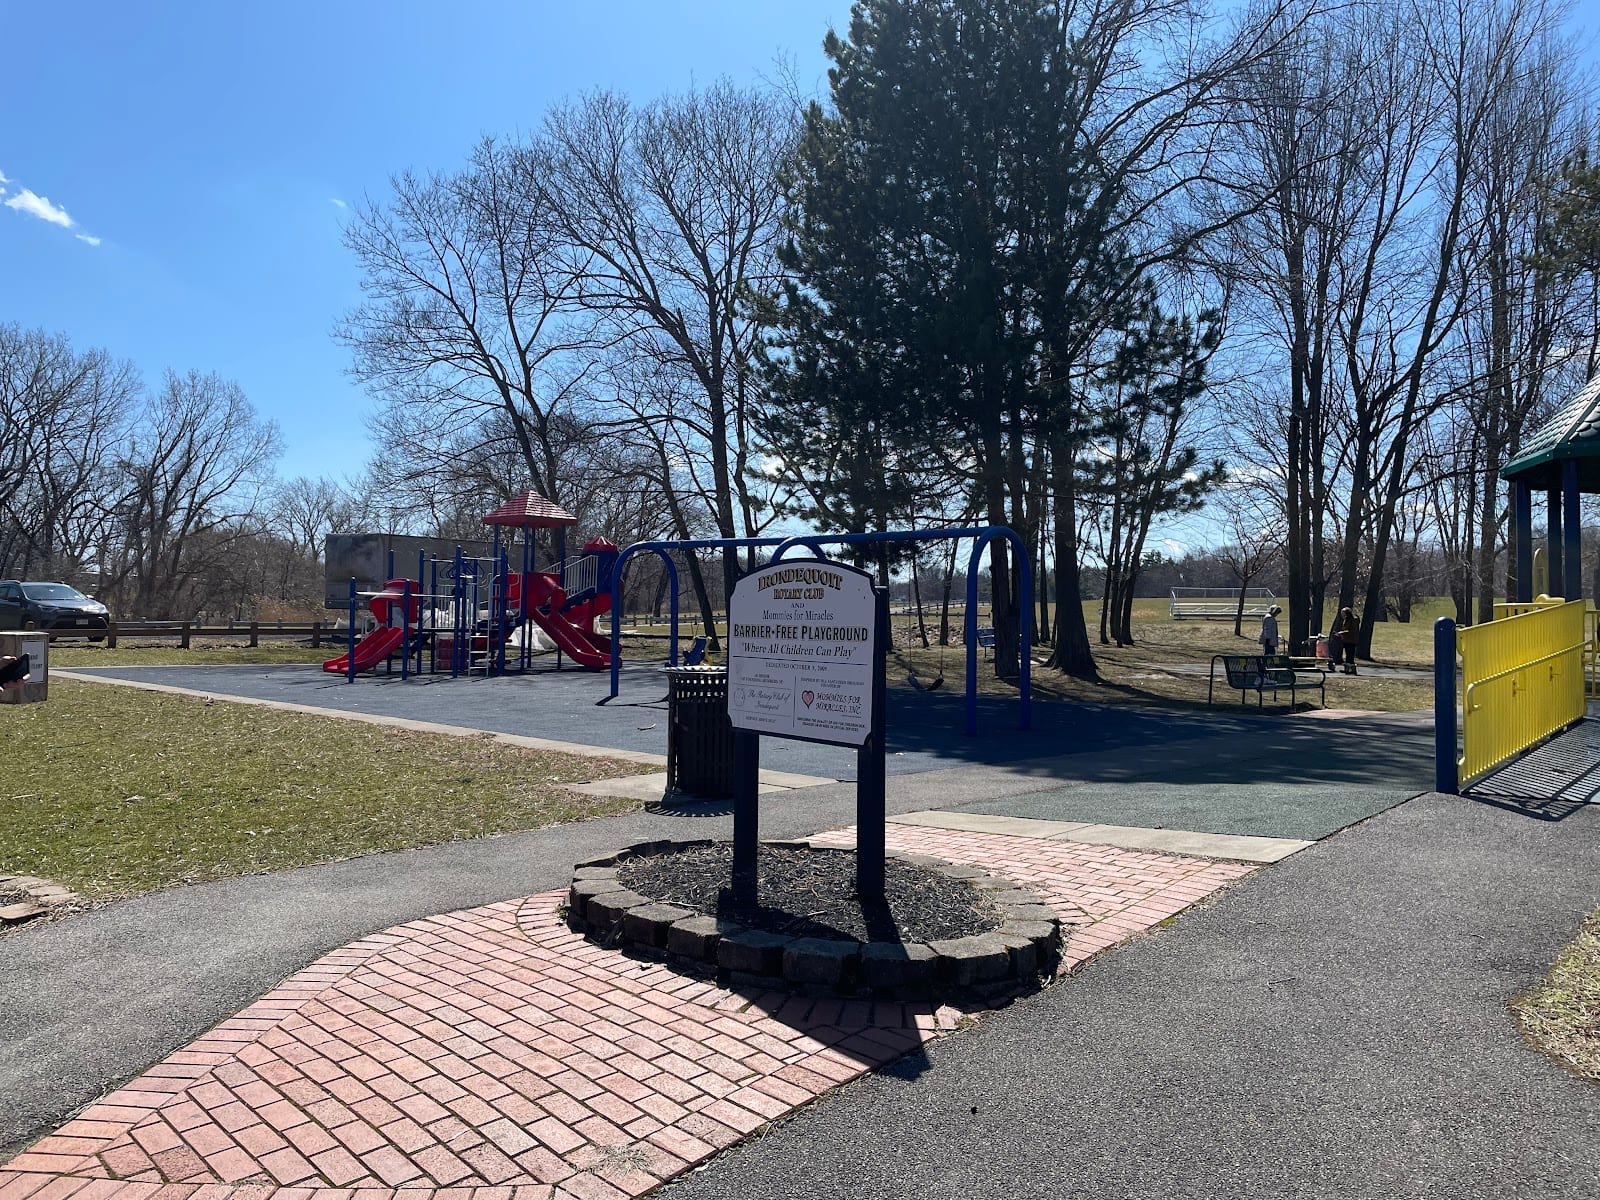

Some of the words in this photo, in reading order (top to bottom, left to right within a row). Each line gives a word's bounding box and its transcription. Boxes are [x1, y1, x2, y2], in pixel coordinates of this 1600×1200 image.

[758, 567, 843, 592] IRONDEQUOIT
[773, 588, 802, 599] ROTARY
[803, 588, 825, 599] CLUB
[762, 610, 793, 620] Mommies
[793, 609, 804, 620] for
[805, 609, 834, 621] Miracles
[801, 625, 868, 641] PLAYGROUND
[768, 643, 779, 654] All
[780, 643, 814, 656] Children
[815, 645, 832, 657] Can
